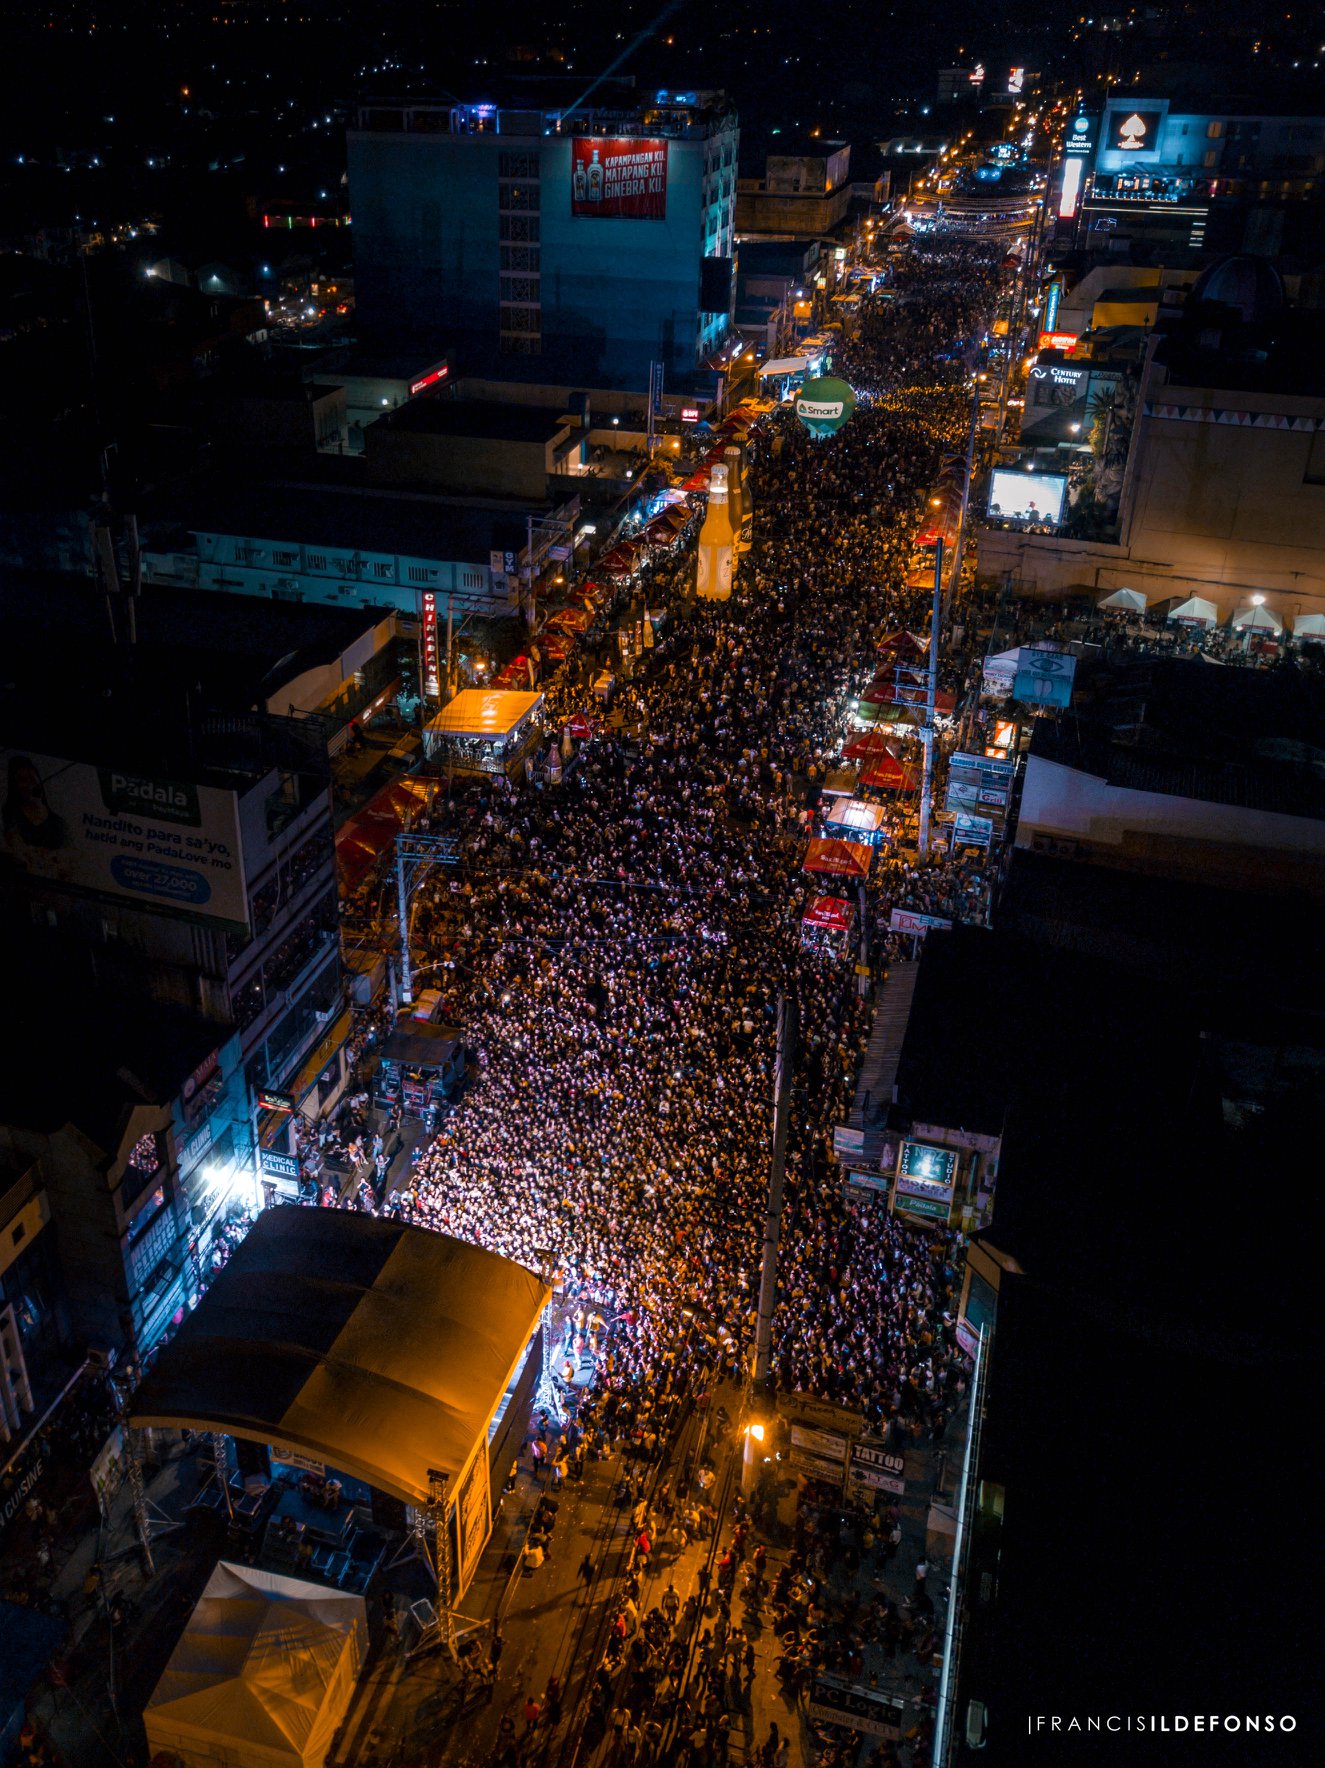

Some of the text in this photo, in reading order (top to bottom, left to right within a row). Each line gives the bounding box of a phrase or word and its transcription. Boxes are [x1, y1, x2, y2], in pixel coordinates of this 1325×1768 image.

[605, 152, 653, 168] KAPAMPANGAN
[605, 162, 664, 182] MATAPANG KU.
[604, 177, 664, 199] GINEBRA KU.
[1051, 367, 1082, 378] CENTURY
[1054, 375, 1077, 385] HOTEL
[807, 406, 839, 415] Smart
[505, 552, 514, 572] GYM
[424, 593, 437, 682] CHINABANK
[112, 774, 188, 806] Padala
[82, 813, 231, 858] Nandito para sa'yo,
[85, 829, 117, 844] hatid
[120, 838, 143, 851] ang
[147, 842, 208, 864] PadaLove
[211, 858, 232, 870] mo
[124, 869, 148, 881] over
[151, 873, 197, 892] 27,000
[262, 1152, 296, 1168] MEDICAL
[262, 1161, 296, 1174] CLINIC
[901, 1143, 911, 1175] TATTOO
[945, 1152, 955, 1184] STUDIO
[898, 1178, 951, 1193] MONEY
[131, 1205, 173, 1266] MEDICAL
[133, 1220, 176, 1281] CLINIC
[854, 1444, 904, 1471] TATTOO
[4, 1457, 44, 1519] CUISINE
[815, 1684, 899, 1720] PC Logic
